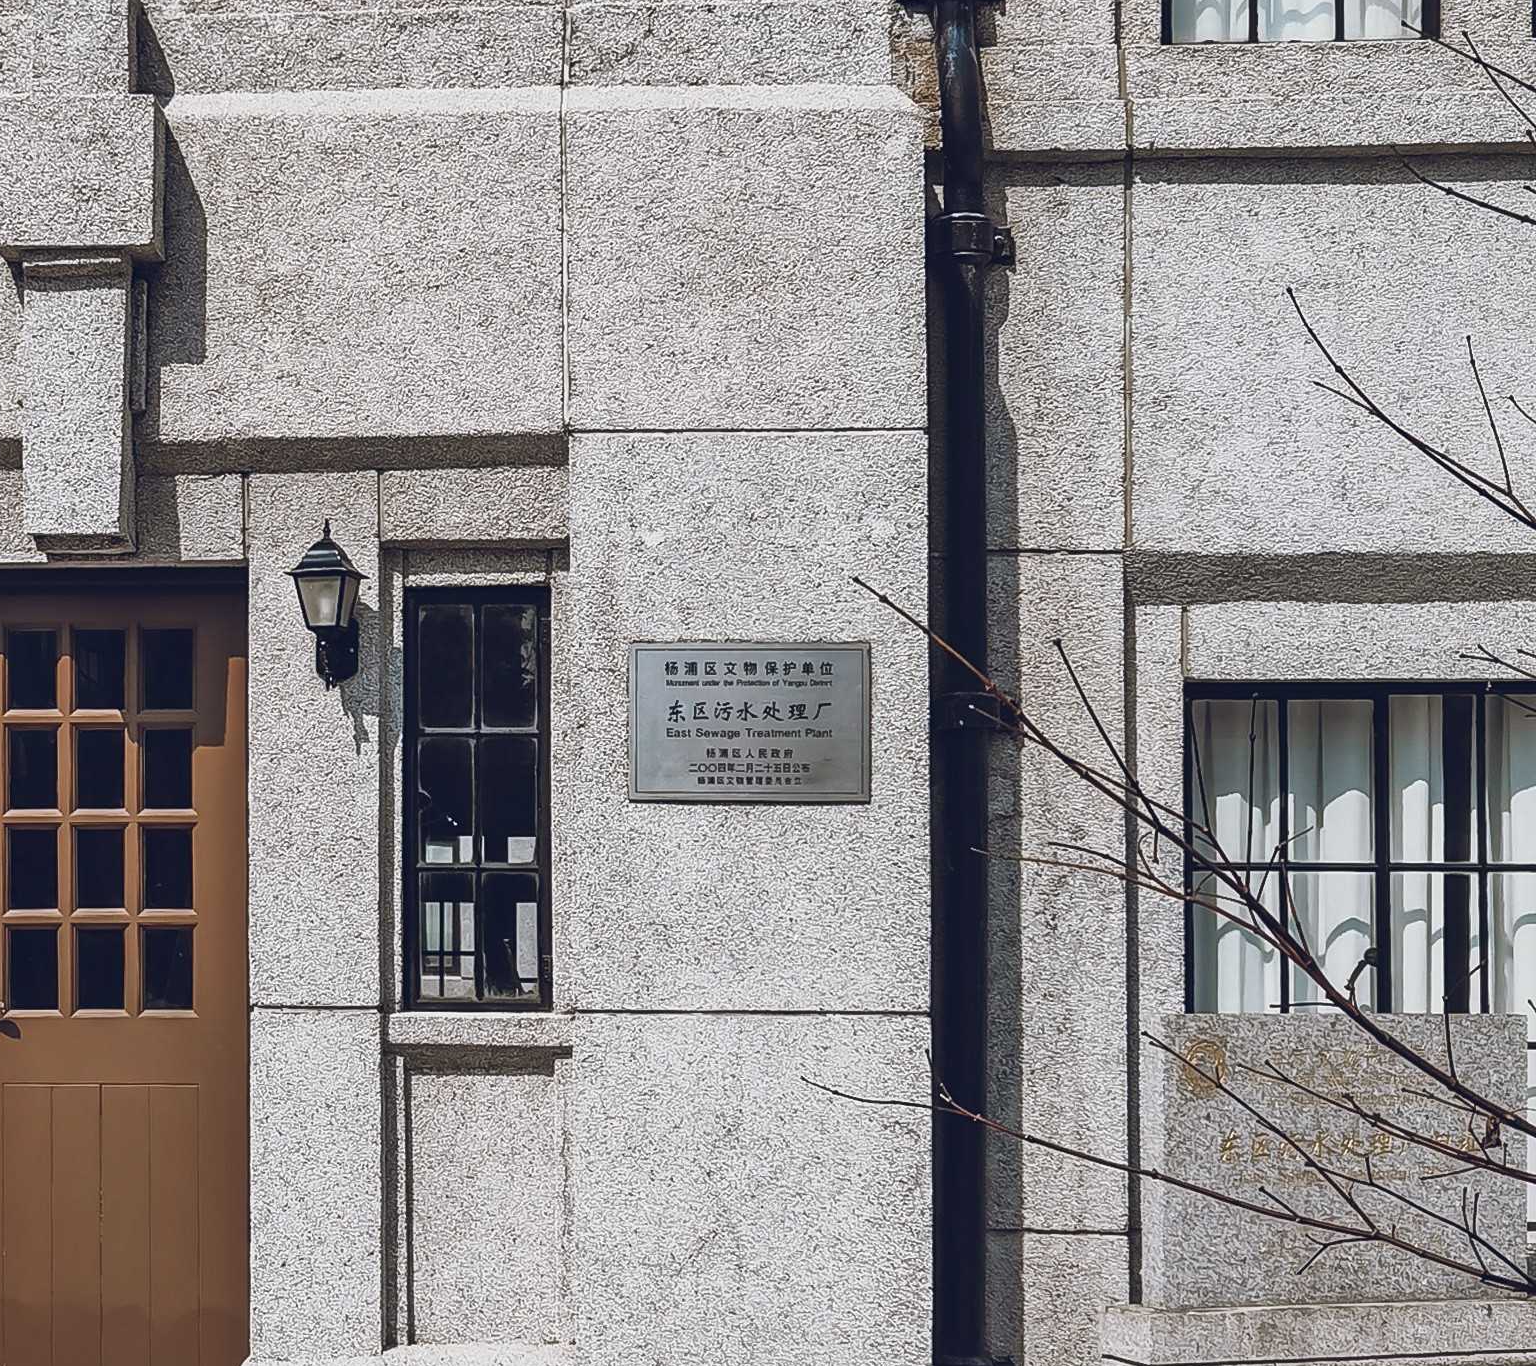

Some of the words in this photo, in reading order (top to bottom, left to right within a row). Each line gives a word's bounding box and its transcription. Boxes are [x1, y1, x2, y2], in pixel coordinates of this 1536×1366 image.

[664, 661, 834, 676] 杨浦区文物保护单位
[667, 700, 833, 723] 东区污水处理厂
[666, 728, 691, 738] East
[695, 728, 741, 740] Sewage
[745, 728, 802, 738] Treatment
[805, 728, 833, 738] Plant
[706, 748, 794, 758] 杨浦区人民政府
